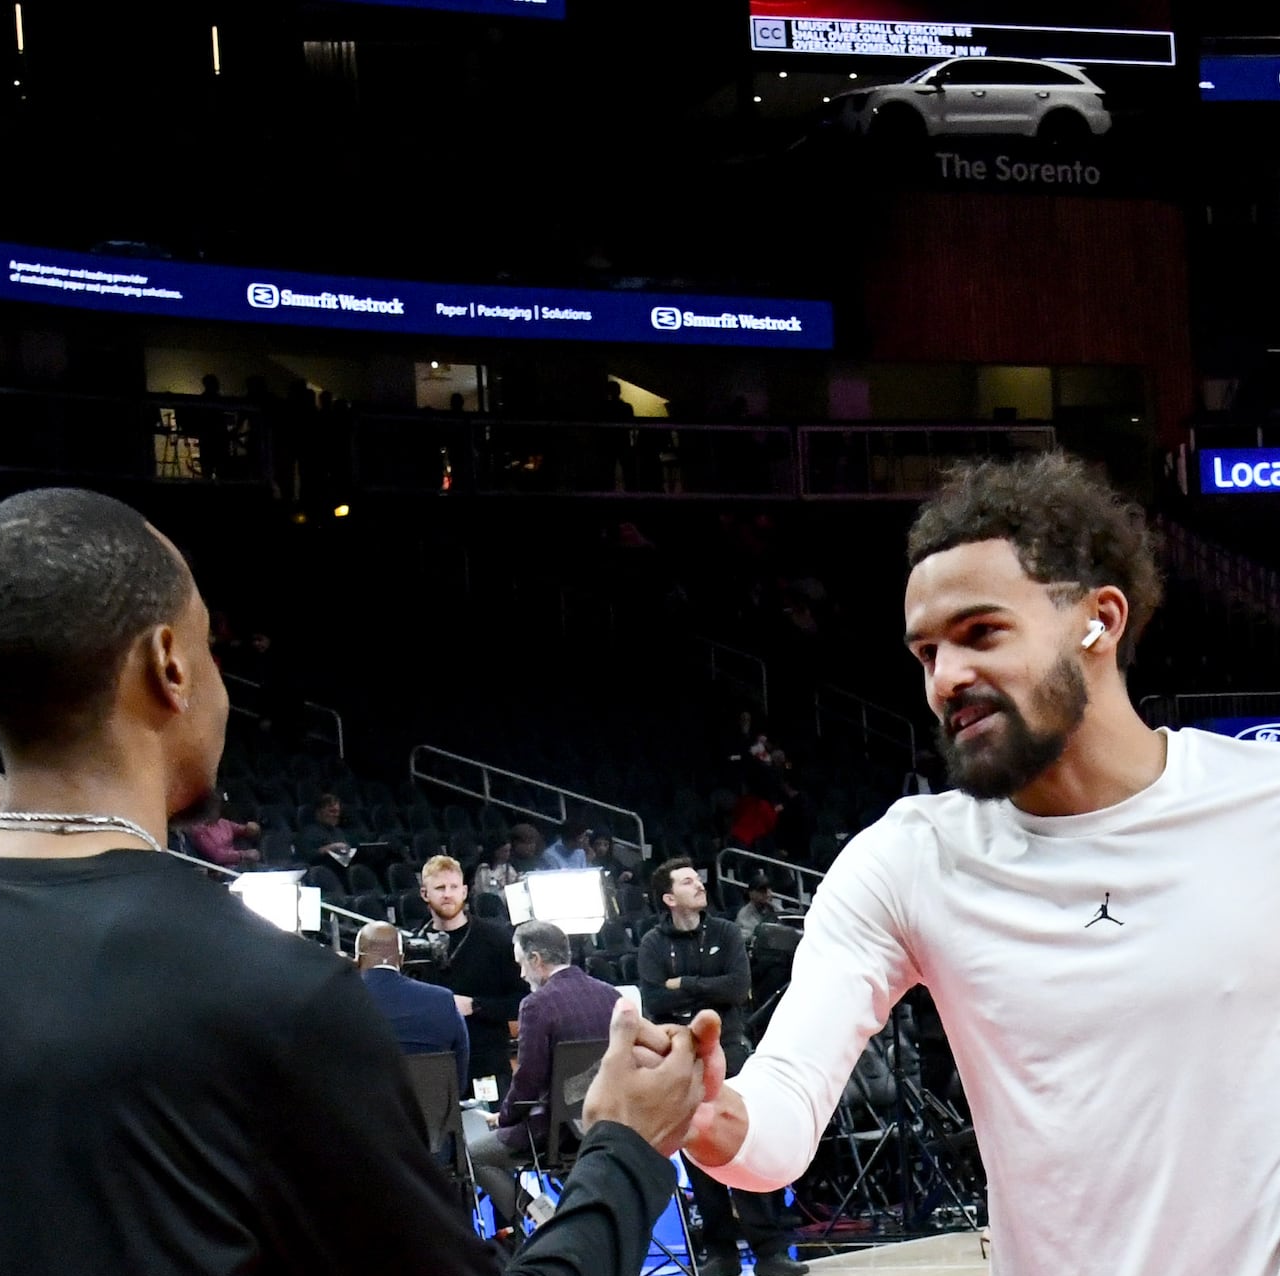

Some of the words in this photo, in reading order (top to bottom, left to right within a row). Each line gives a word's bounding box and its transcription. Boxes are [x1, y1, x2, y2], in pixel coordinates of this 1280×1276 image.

[760, 27, 782, 40] CC
[792, 31, 826, 41] SHALL
[827, 32, 887, 43] OVERCOME
[888, 34, 906, 44] WE
[907, 35, 942, 45] SHALL
[859, 23, 893, 34] SHALL
[894, 24, 954, 36] OVERCOME
[955, 27, 972, 37] WE
[792, 40, 852, 51] OVERCOME
[936, 152, 987, 180] The
[996, 156, 1100, 185] Sorento
[281, 289, 338, 309] Smurfit
[338, 294, 404, 314] Westrock
[436, 303, 467, 317] Paper
[478, 305, 532, 321] Packaging
[542, 307, 592, 320] Solutions
[683, 312, 739, 328] Smurfit
[738, 314, 801, 331] Westrock
